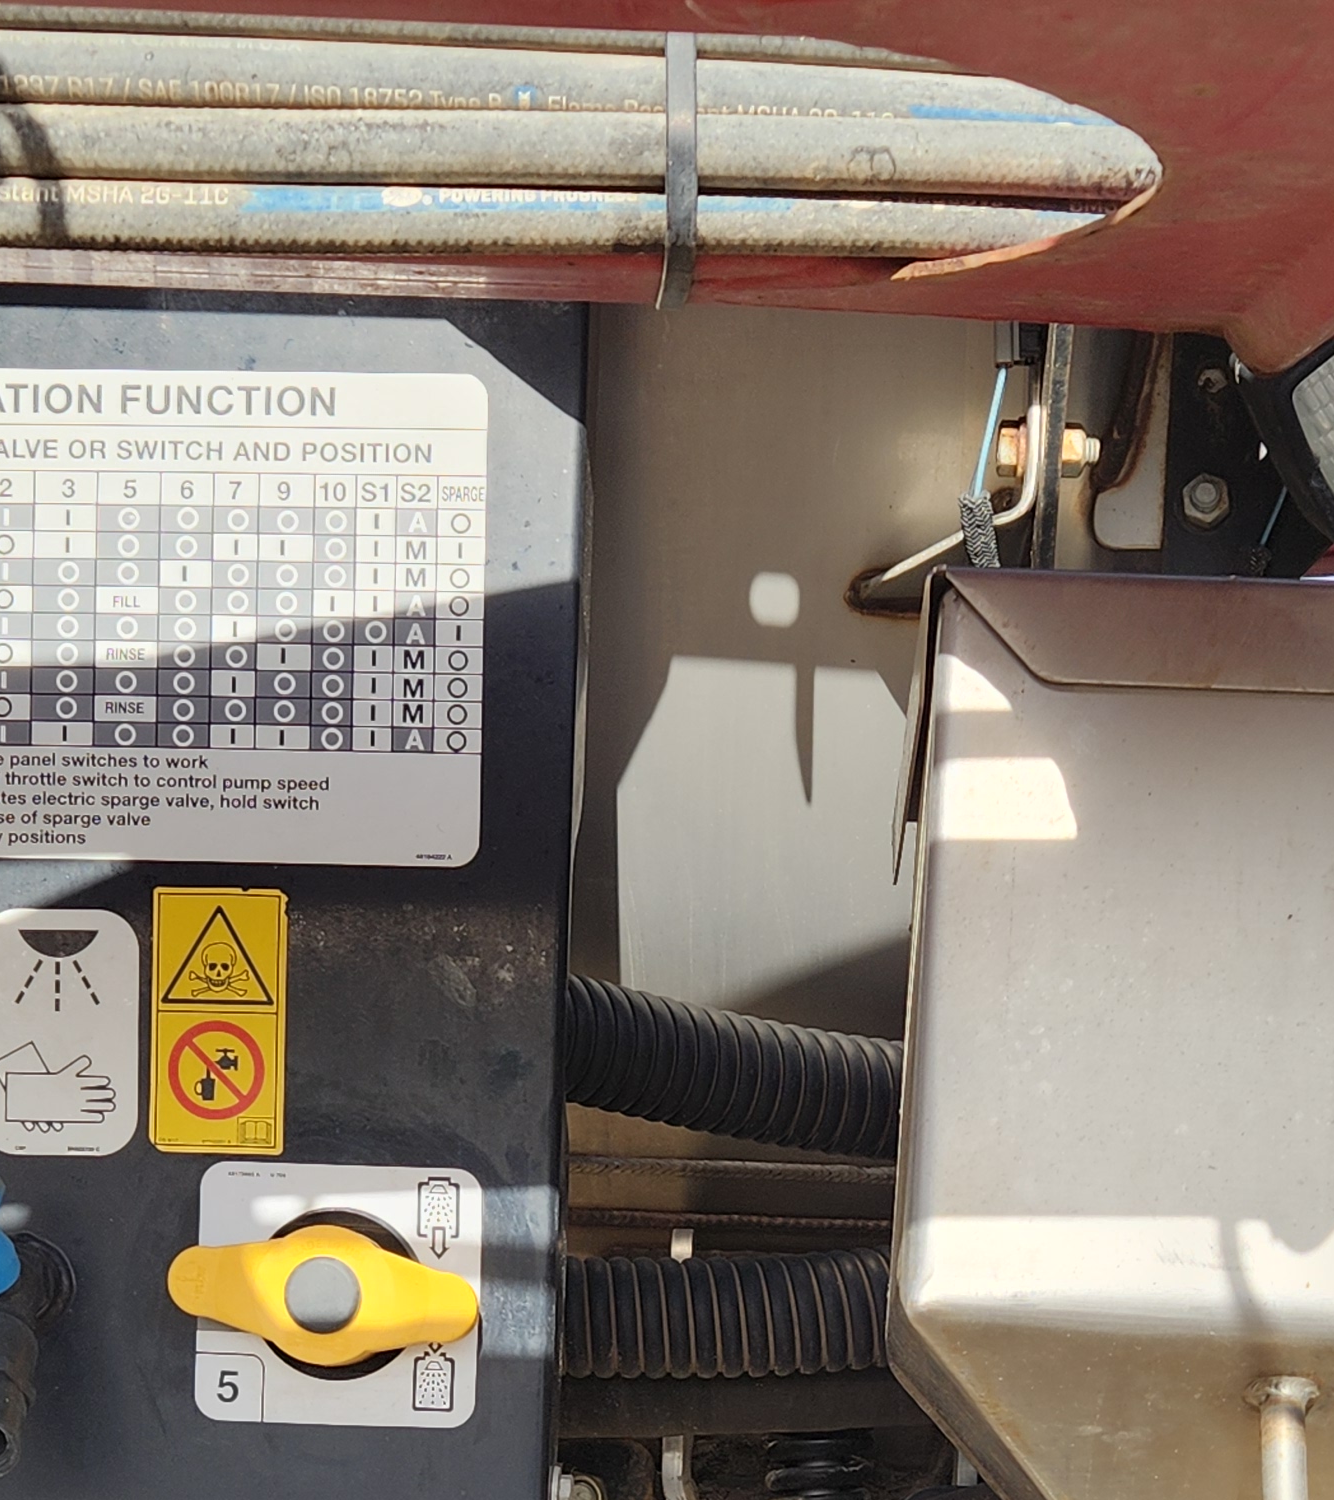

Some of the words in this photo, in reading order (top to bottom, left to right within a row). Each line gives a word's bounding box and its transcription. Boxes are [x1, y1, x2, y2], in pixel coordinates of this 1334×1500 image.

[69, 185, 133, 204] MSHA
[120, 384, 337, 417] FUNCTION
[68, 440, 106, 460] OR
[117, 440, 223, 462] SWITCH
[233, 442, 290, 463] AND
[302, 443, 432, 465] POSITION
[61, 479, 75, 499] 3
[123, 480, 137, 499] 5
[180, 480, 193, 500] 6
[228, 482, 242, 500] 7
[277, 482, 291, 500] 9
[319, 482, 347, 502] 10
[361, 482, 390, 502] S1
[400, 484, 431, 502] S2
[441, 486, 485, 502] SPARGE
[405, 541, 426, 560] M
[113, 596, 140, 608] FILL
[106, 648, 145, 661] RINSE
[105, 702, 145, 714] RINSE
[10, 753, 56, 770] panel
[61, 754, 137, 769] switches
[166, 755, 208, 769] work
[5, 772, 66, 786] throttle
[72, 773, 129, 788] switch
[157, 775, 216, 789] control
[223, 778, 272, 793] pump
[277, 777, 329, 793] speed
[32, 791, 95, 807] electric
[101, 793, 160, 809] sparge
[166, 794, 215, 811] valve,
[220, 794, 257, 810] hold
[263, 795, 319, 811] switch
[43, 812, 101, 828] sparge
[108, 813, 151, 827] valve
[8, 829, 86, 846] positions
[216, 1370, 239, 1402] 5
